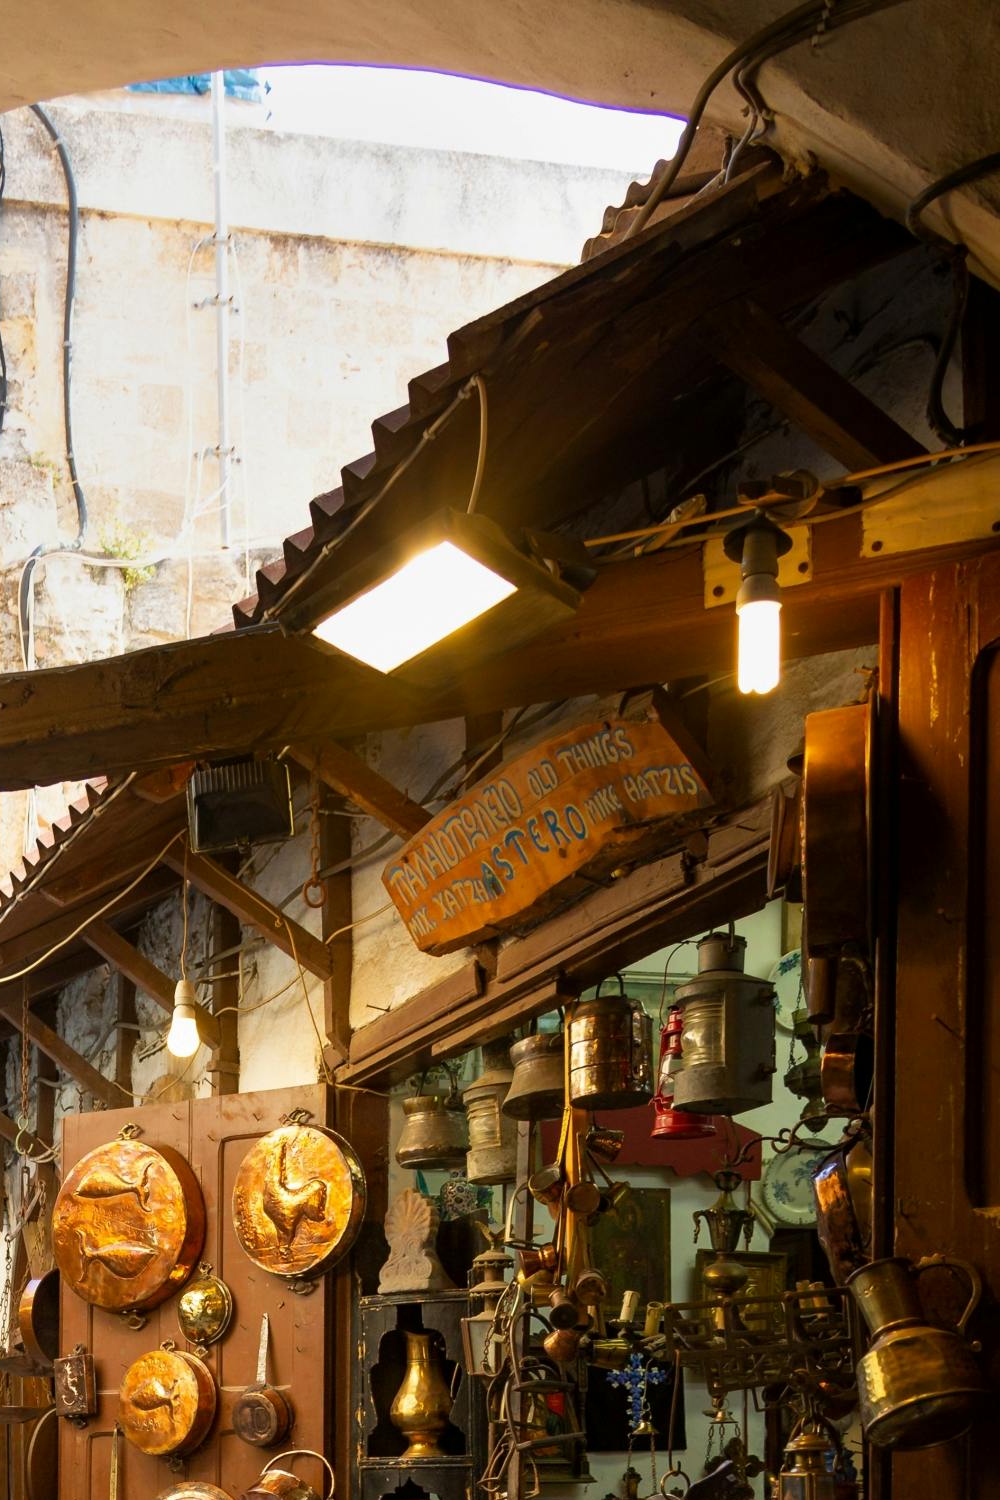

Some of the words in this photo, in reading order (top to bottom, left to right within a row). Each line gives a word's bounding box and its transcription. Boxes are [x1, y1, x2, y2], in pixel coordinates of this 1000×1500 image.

[526, 758, 559, 799] OLD
[557, 728, 635, 777] THINGS
[585, 784, 624, 824] MIKE
[623, 763, 699, 803] HATZIS
